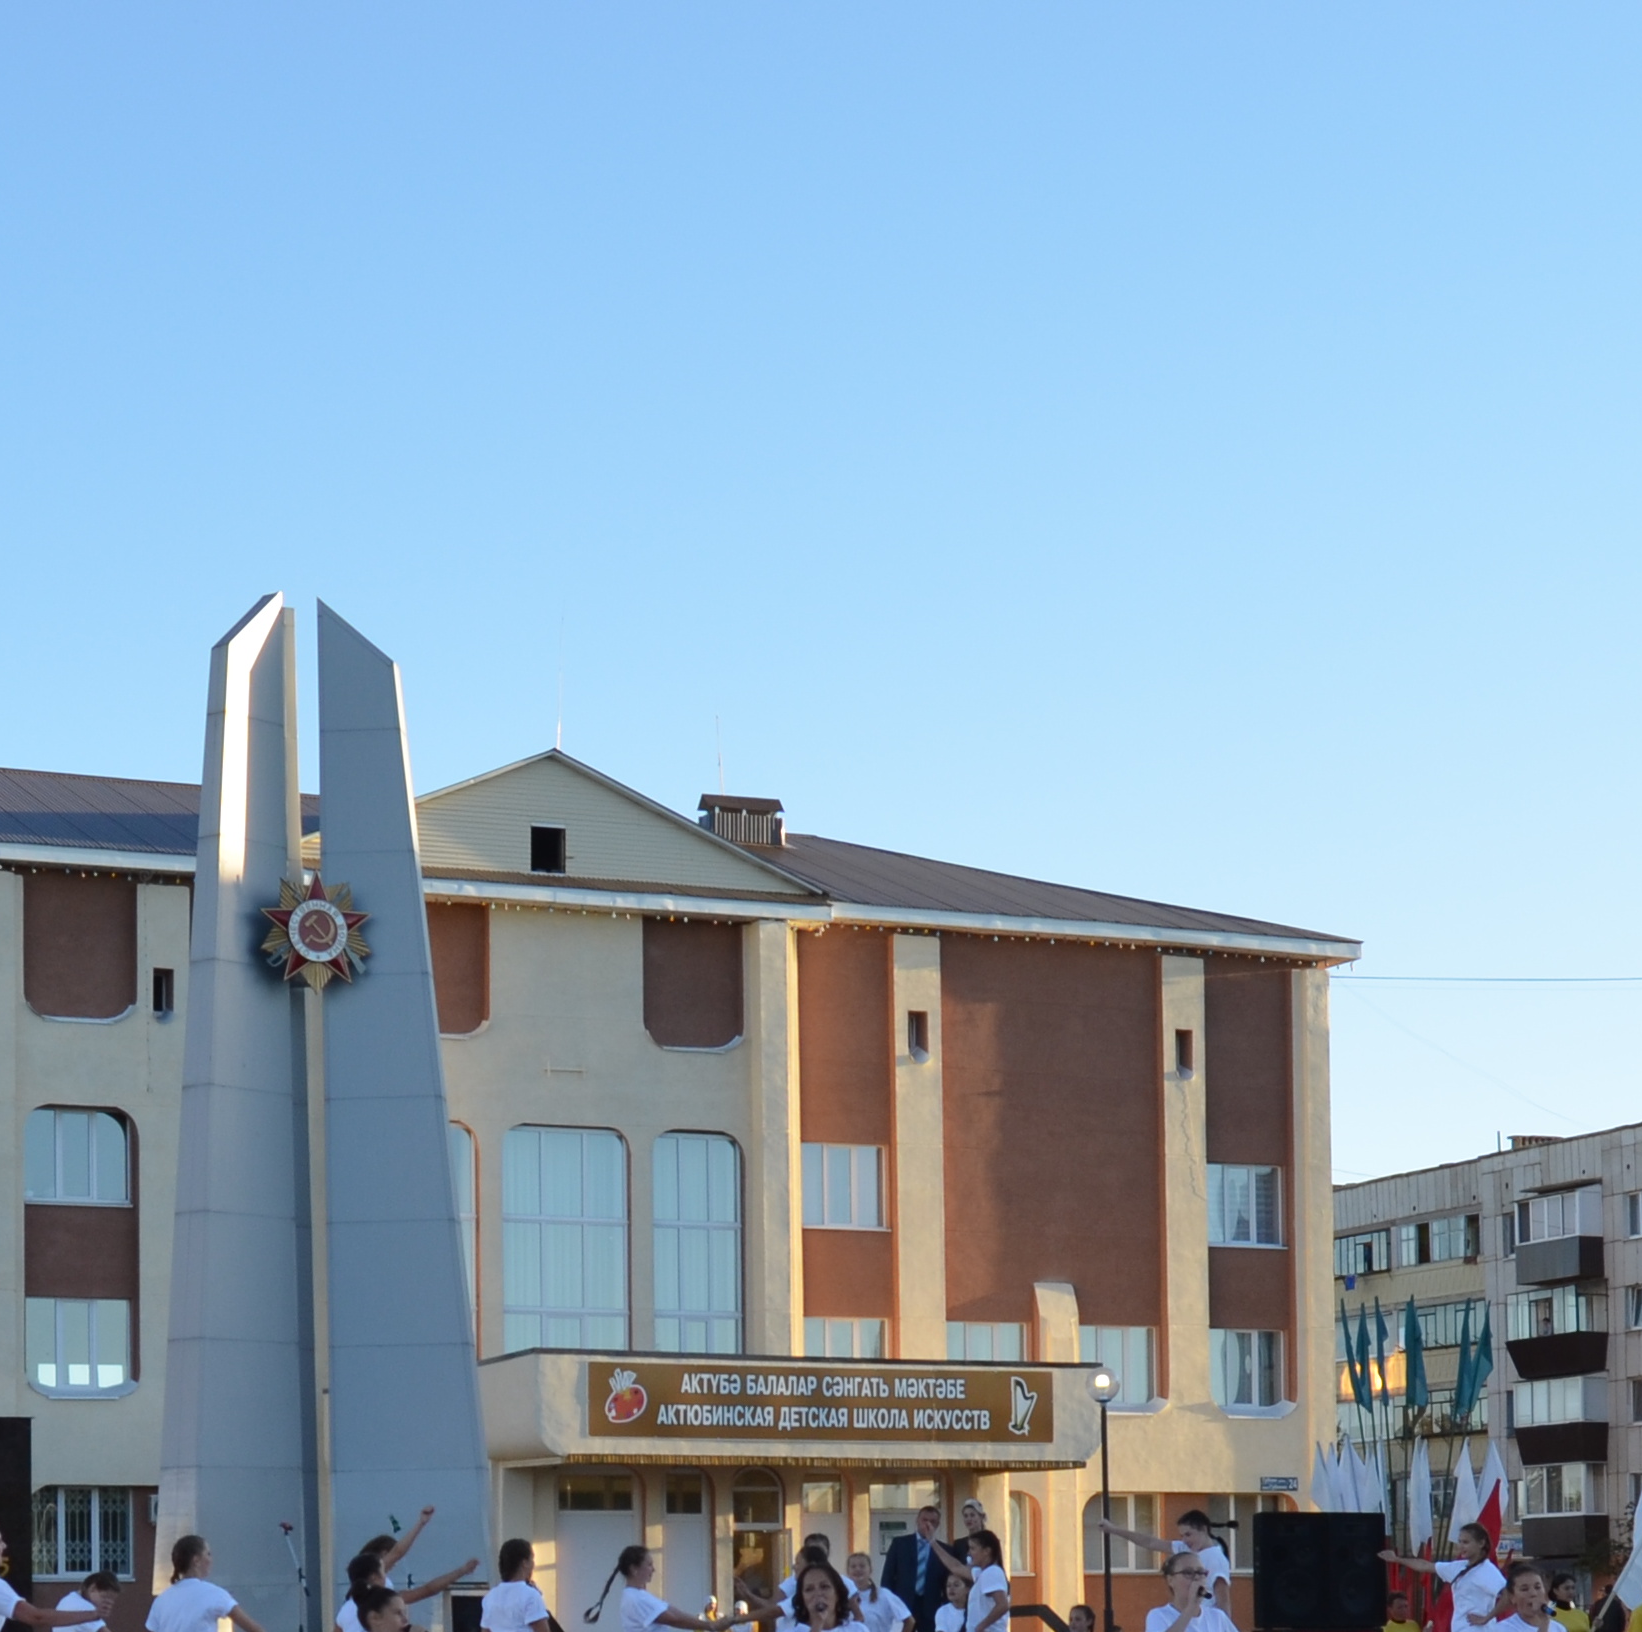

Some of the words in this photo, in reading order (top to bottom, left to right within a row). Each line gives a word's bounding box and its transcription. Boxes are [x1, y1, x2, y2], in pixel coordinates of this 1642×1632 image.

[681, 1373, 741, 1395] АКТҮБӘ
[746, 1375, 817, 1396] БАЛАЛАР
[822, 1376, 889, 1397] СӘНГАТЬ
[894, 1378, 966, 1399] МӘКТӘБЕ
[657, 1404, 774, 1427] АКТЮБИНСКАЯ
[778, 1407, 848, 1431] ДЕТСКАЯ
[853, 1408, 909, 1429] ШКОЛА
[914, 1409, 990, 1430] ИСКУССТВ
